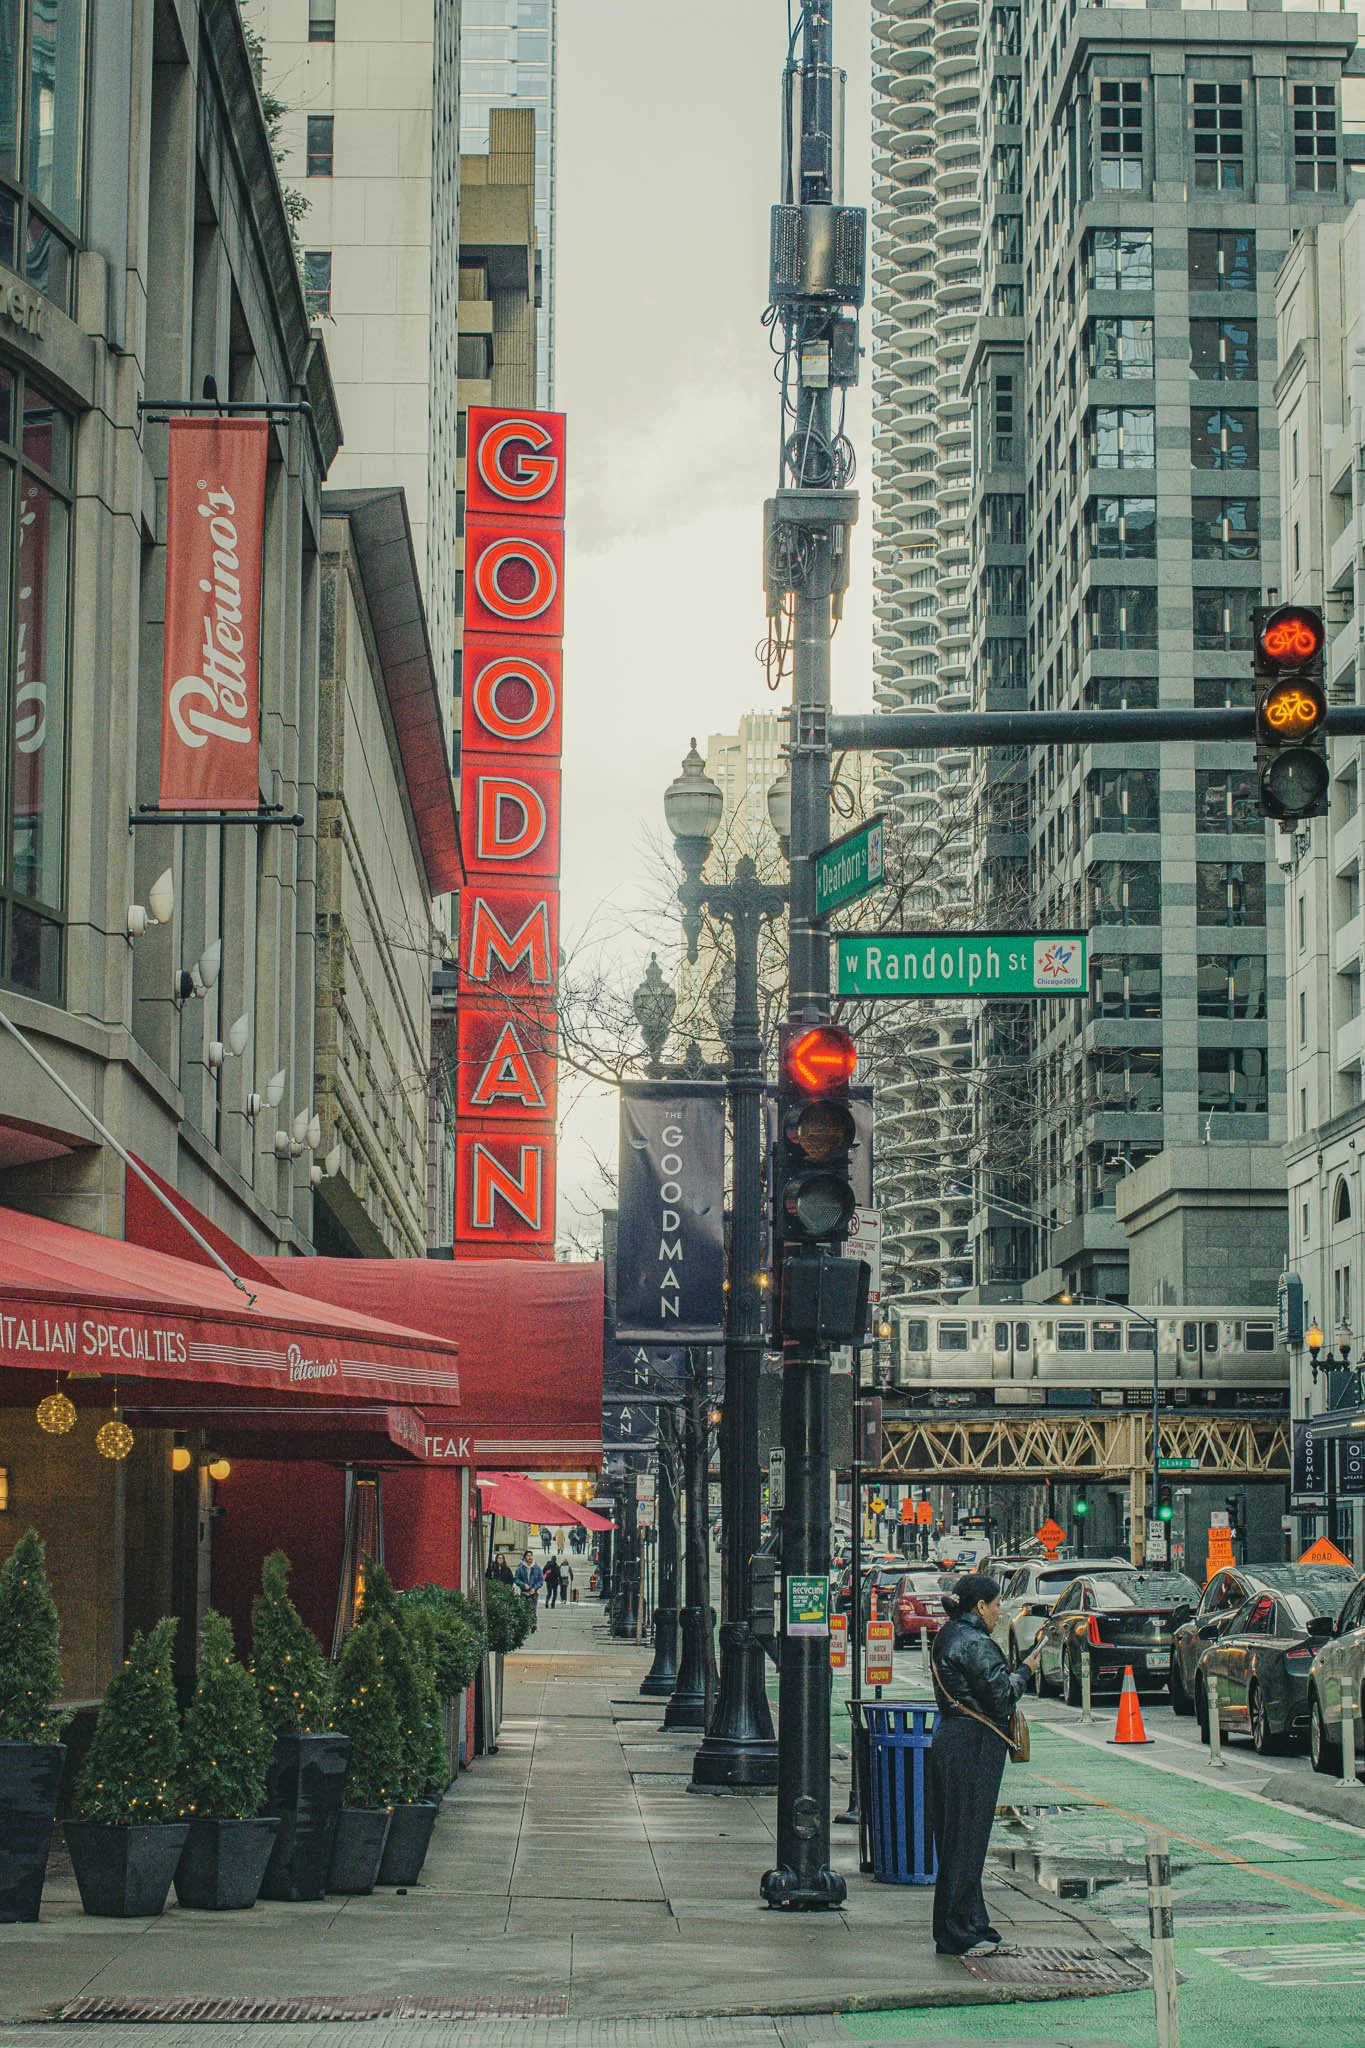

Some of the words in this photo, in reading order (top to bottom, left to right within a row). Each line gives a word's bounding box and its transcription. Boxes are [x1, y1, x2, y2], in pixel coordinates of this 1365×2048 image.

[168, 485, 252, 748] Petterino's
[468, 418, 559, 1229] GOODMAN
[822, 852, 860, 897] Dearborn
[846, 955, 858, 973] W
[866, 946, 1000, 987] Randolph
[1008, 953, 1027, 971] St
[664, 1111, 682, 1119] THE
[658, 1125, 684, 1318] GOODMAN
[82, 1320, 187, 1363] SPECIALTIES
[1167, 1459, 1183, 1467] Lake
[1305, 1431, 1314, 1489] GOODMAN
[1311, 1553, 1333, 1561] ROAD
[871, 1627, 890, 1637] CAUTION
[870, 1670, 889, 1680] CAUTION
